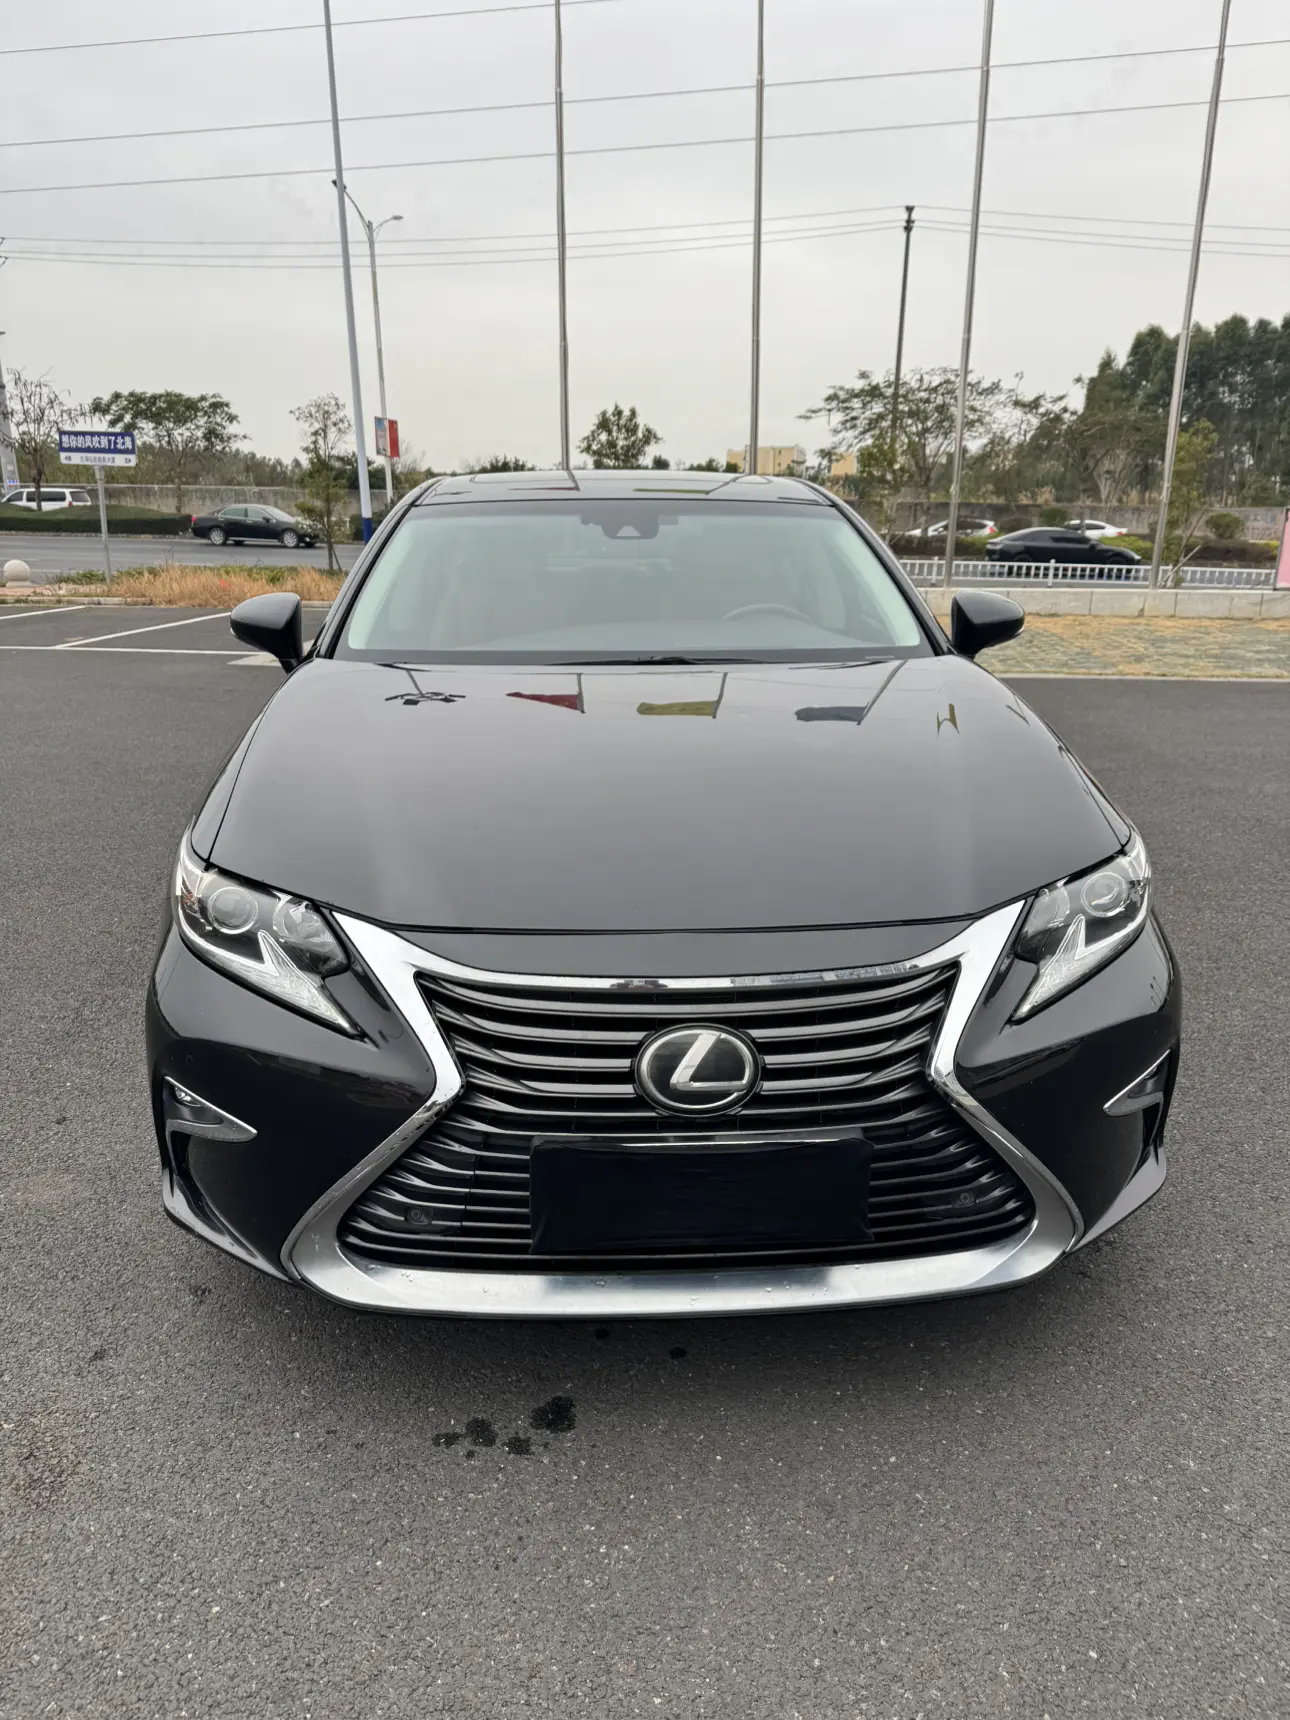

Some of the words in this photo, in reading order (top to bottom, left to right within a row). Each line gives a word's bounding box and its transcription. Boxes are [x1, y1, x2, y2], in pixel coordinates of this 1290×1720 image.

[61, 433, 133, 450] 想你的风吹到了北海
